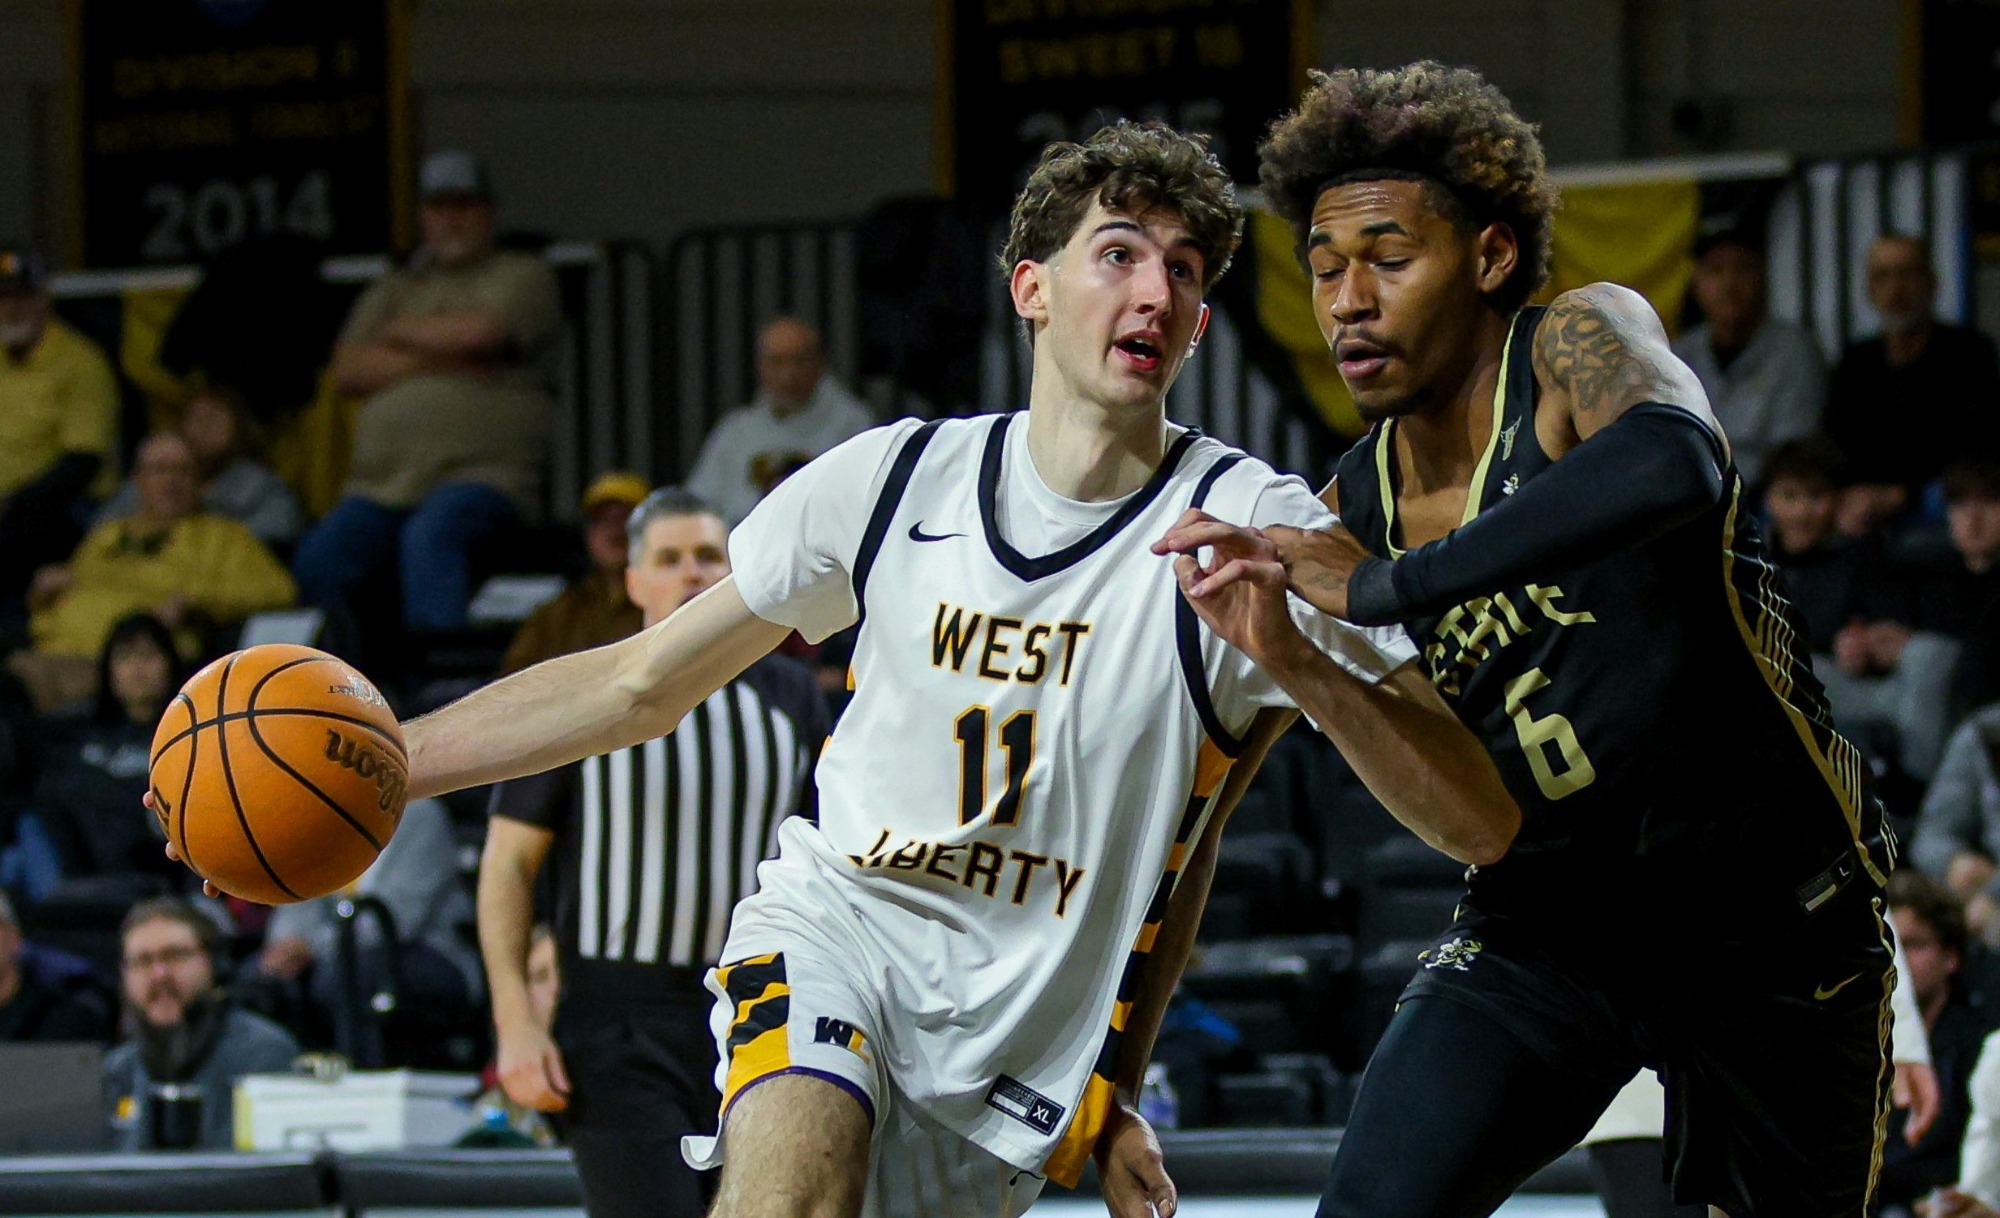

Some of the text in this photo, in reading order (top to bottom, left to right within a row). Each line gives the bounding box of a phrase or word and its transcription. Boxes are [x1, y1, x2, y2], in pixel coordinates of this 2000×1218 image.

[139, 167, 337, 262] 2014
[931, 601, 1092, 687] WEST
[953, 703, 1038, 828] 11
[1503, 667, 1596, 800] 6
[1032, 1104, 1050, 1125] XL
